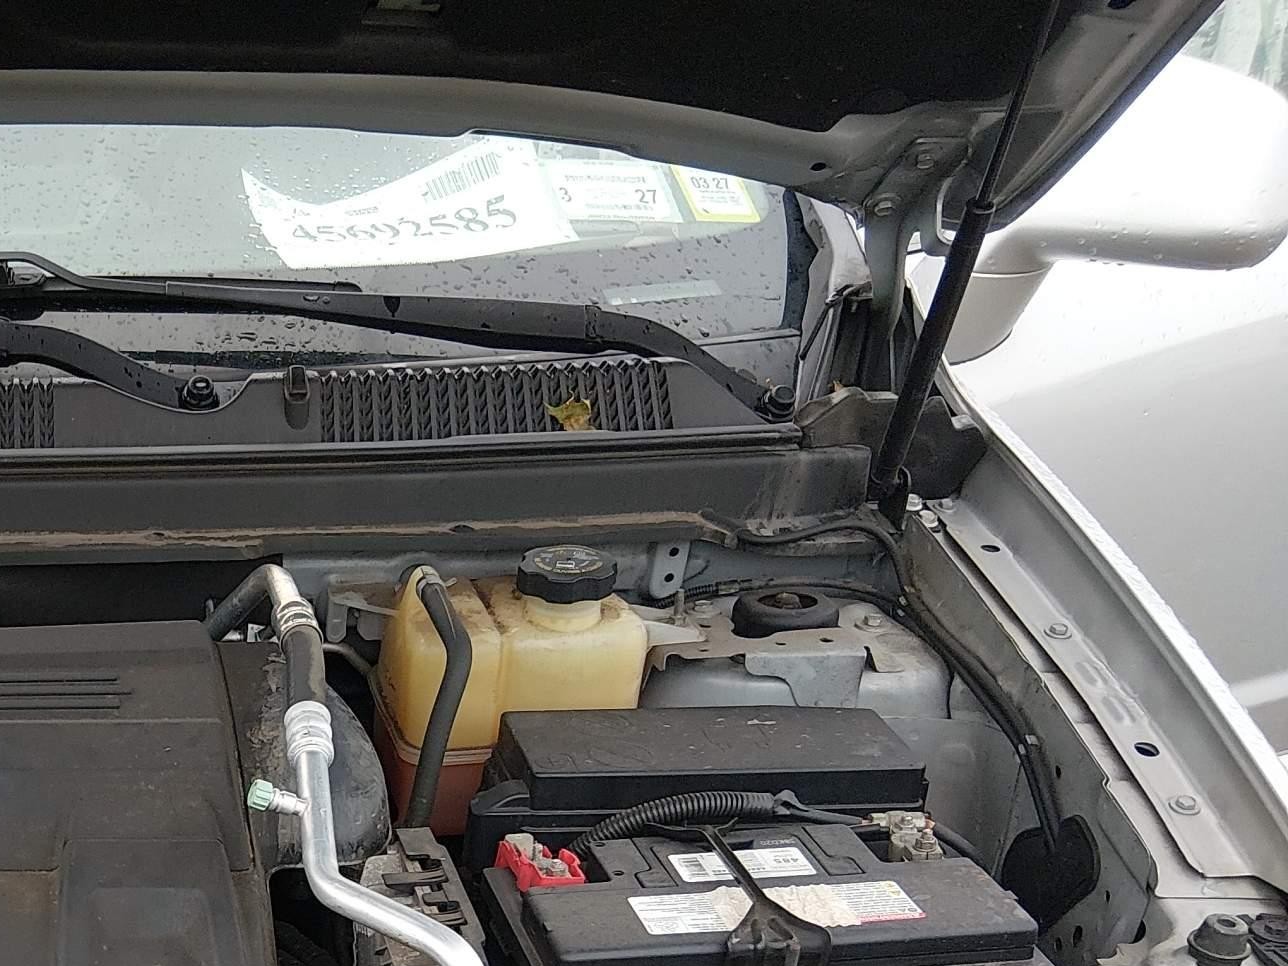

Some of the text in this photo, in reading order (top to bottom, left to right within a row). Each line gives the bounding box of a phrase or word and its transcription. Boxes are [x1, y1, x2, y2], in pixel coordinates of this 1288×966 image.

[691, 176, 730, 190] 03 27
[634, 188, 657, 205] 27
